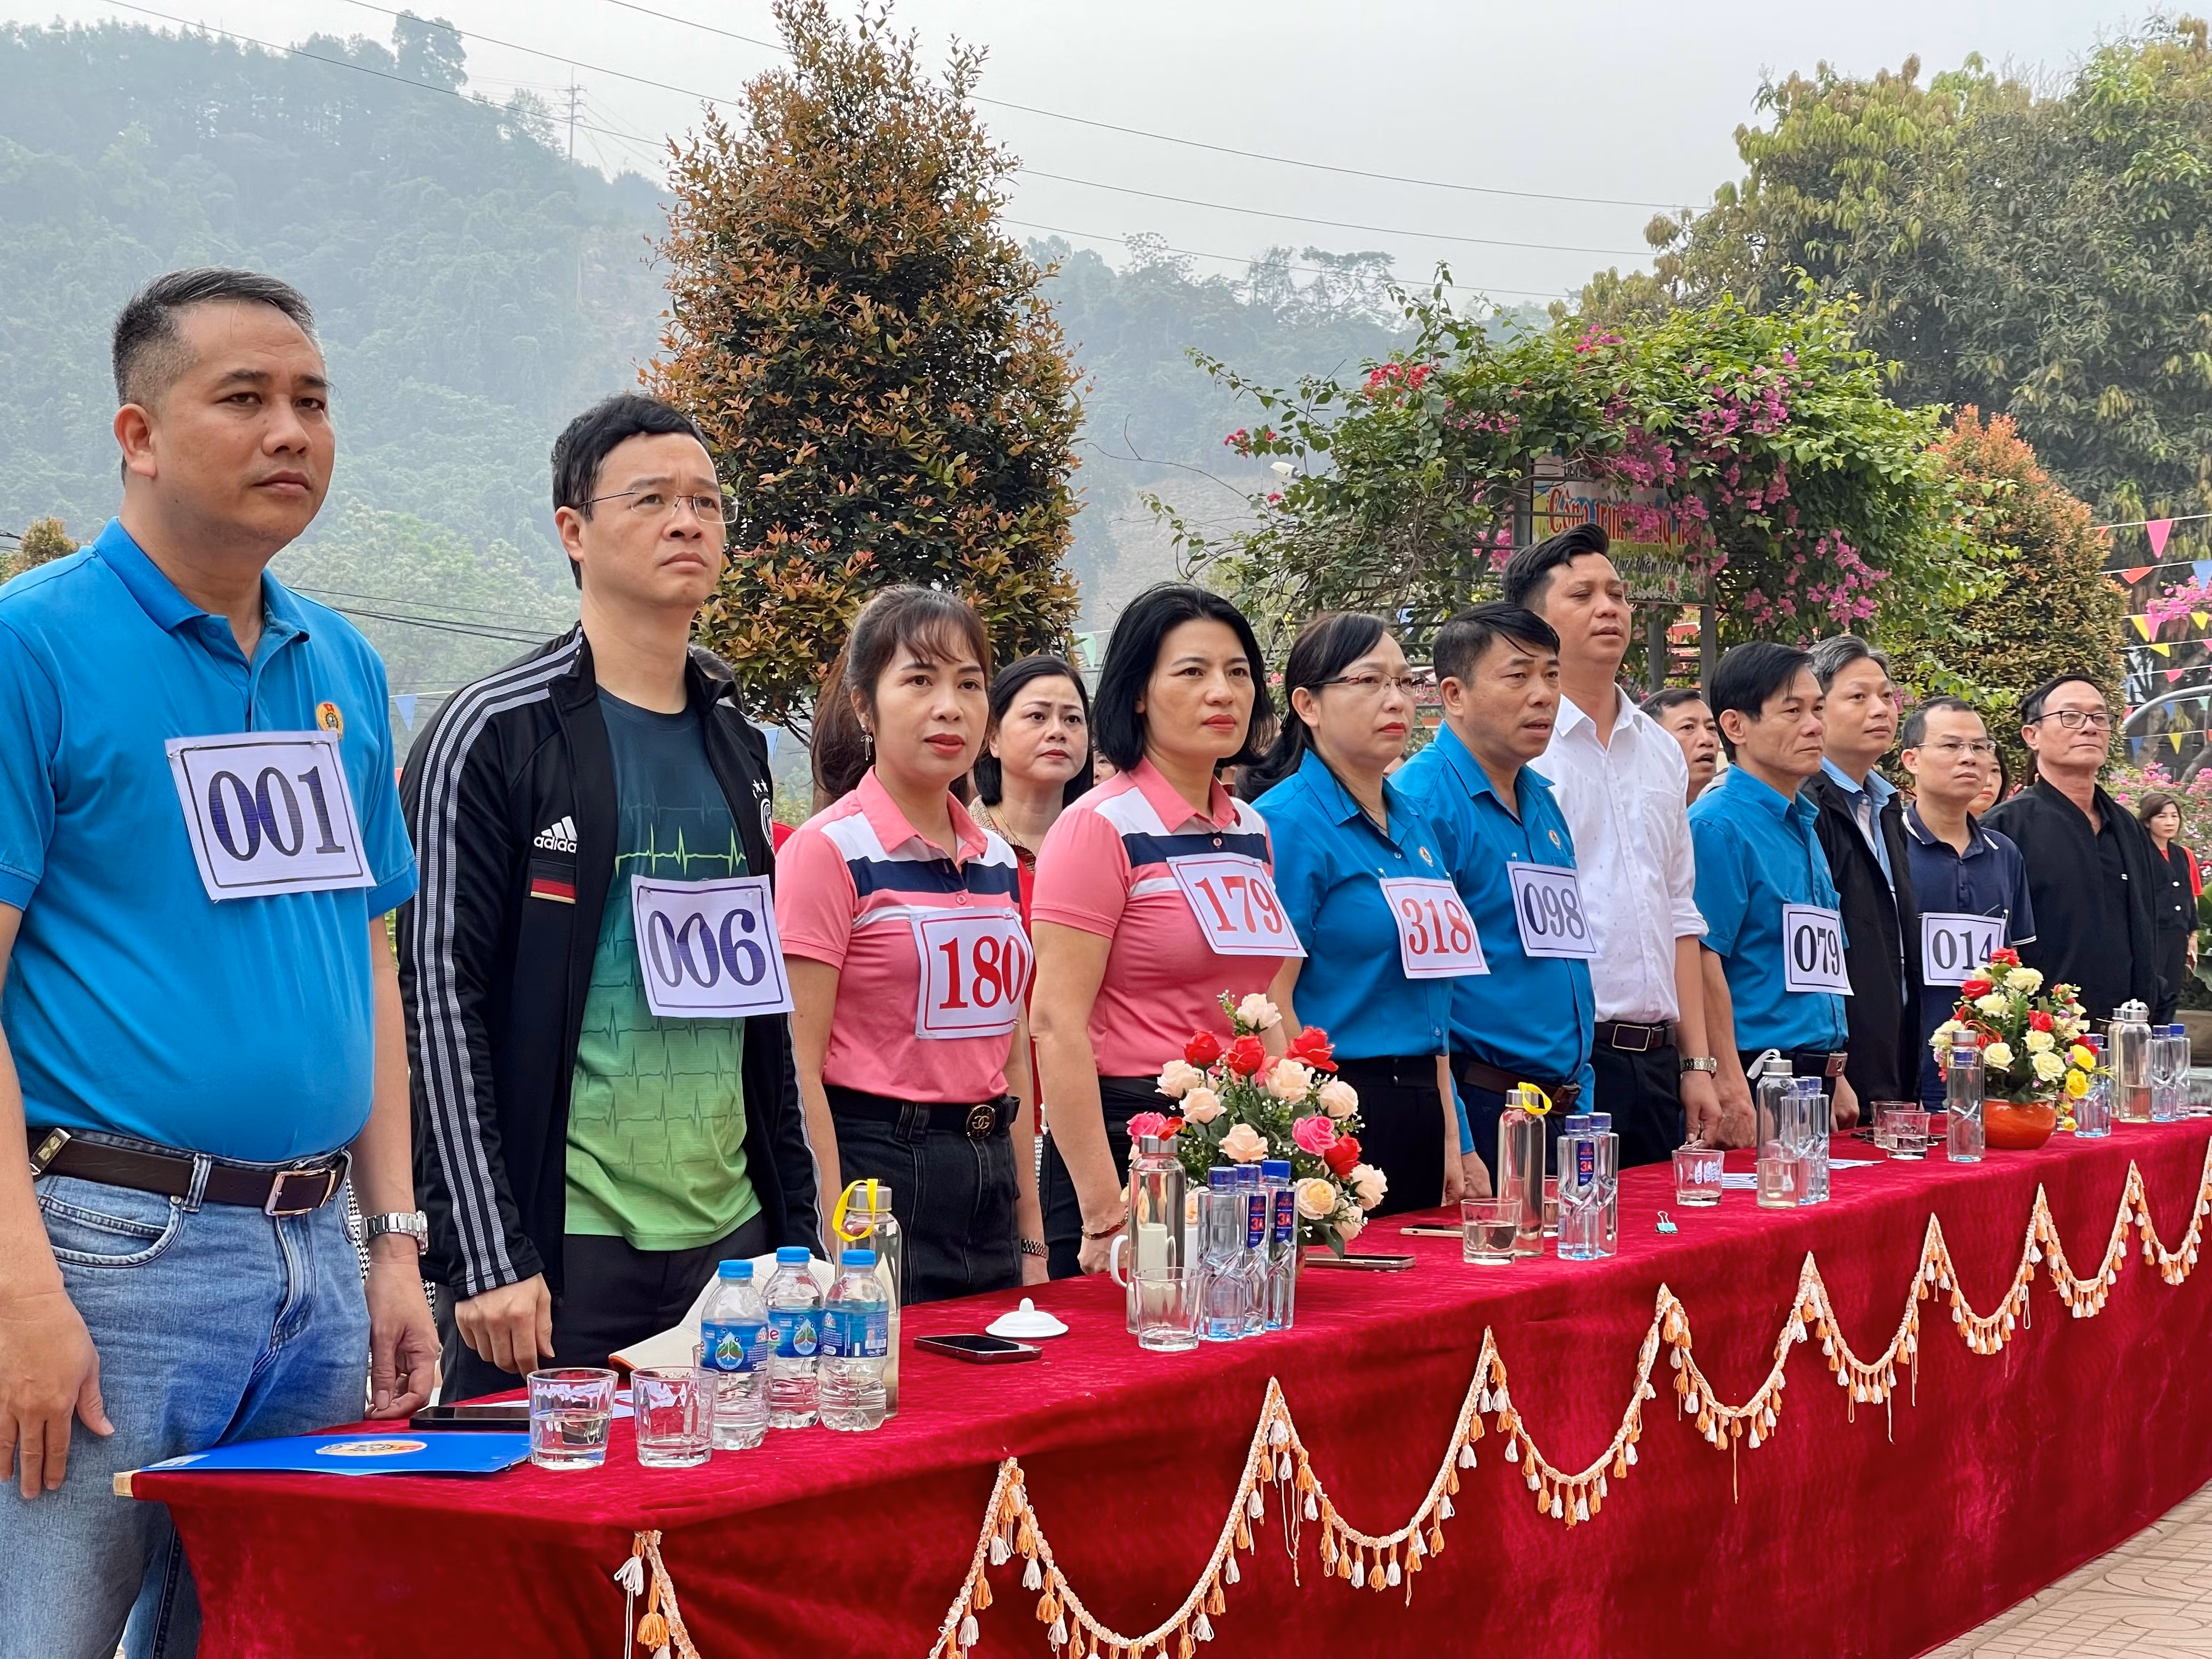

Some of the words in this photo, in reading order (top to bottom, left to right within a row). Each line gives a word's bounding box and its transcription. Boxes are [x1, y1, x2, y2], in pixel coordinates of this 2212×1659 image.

[208, 766, 346, 861] 001
[534, 836, 577, 854] adida
[1194, 876, 1283, 934] 179
[1401, 898, 1471, 955] 318
[1523, 882, 1585, 940] 098
[647, 909, 766, 988] 006
[939, 935, 1026, 1009] 180
[1794, 924, 1840, 977] 079
[1581, 1161, 1593, 1172] 3A
[1251, 1217, 1264, 1231] 3A
[1277, 1213, 1291, 1226] 3A
